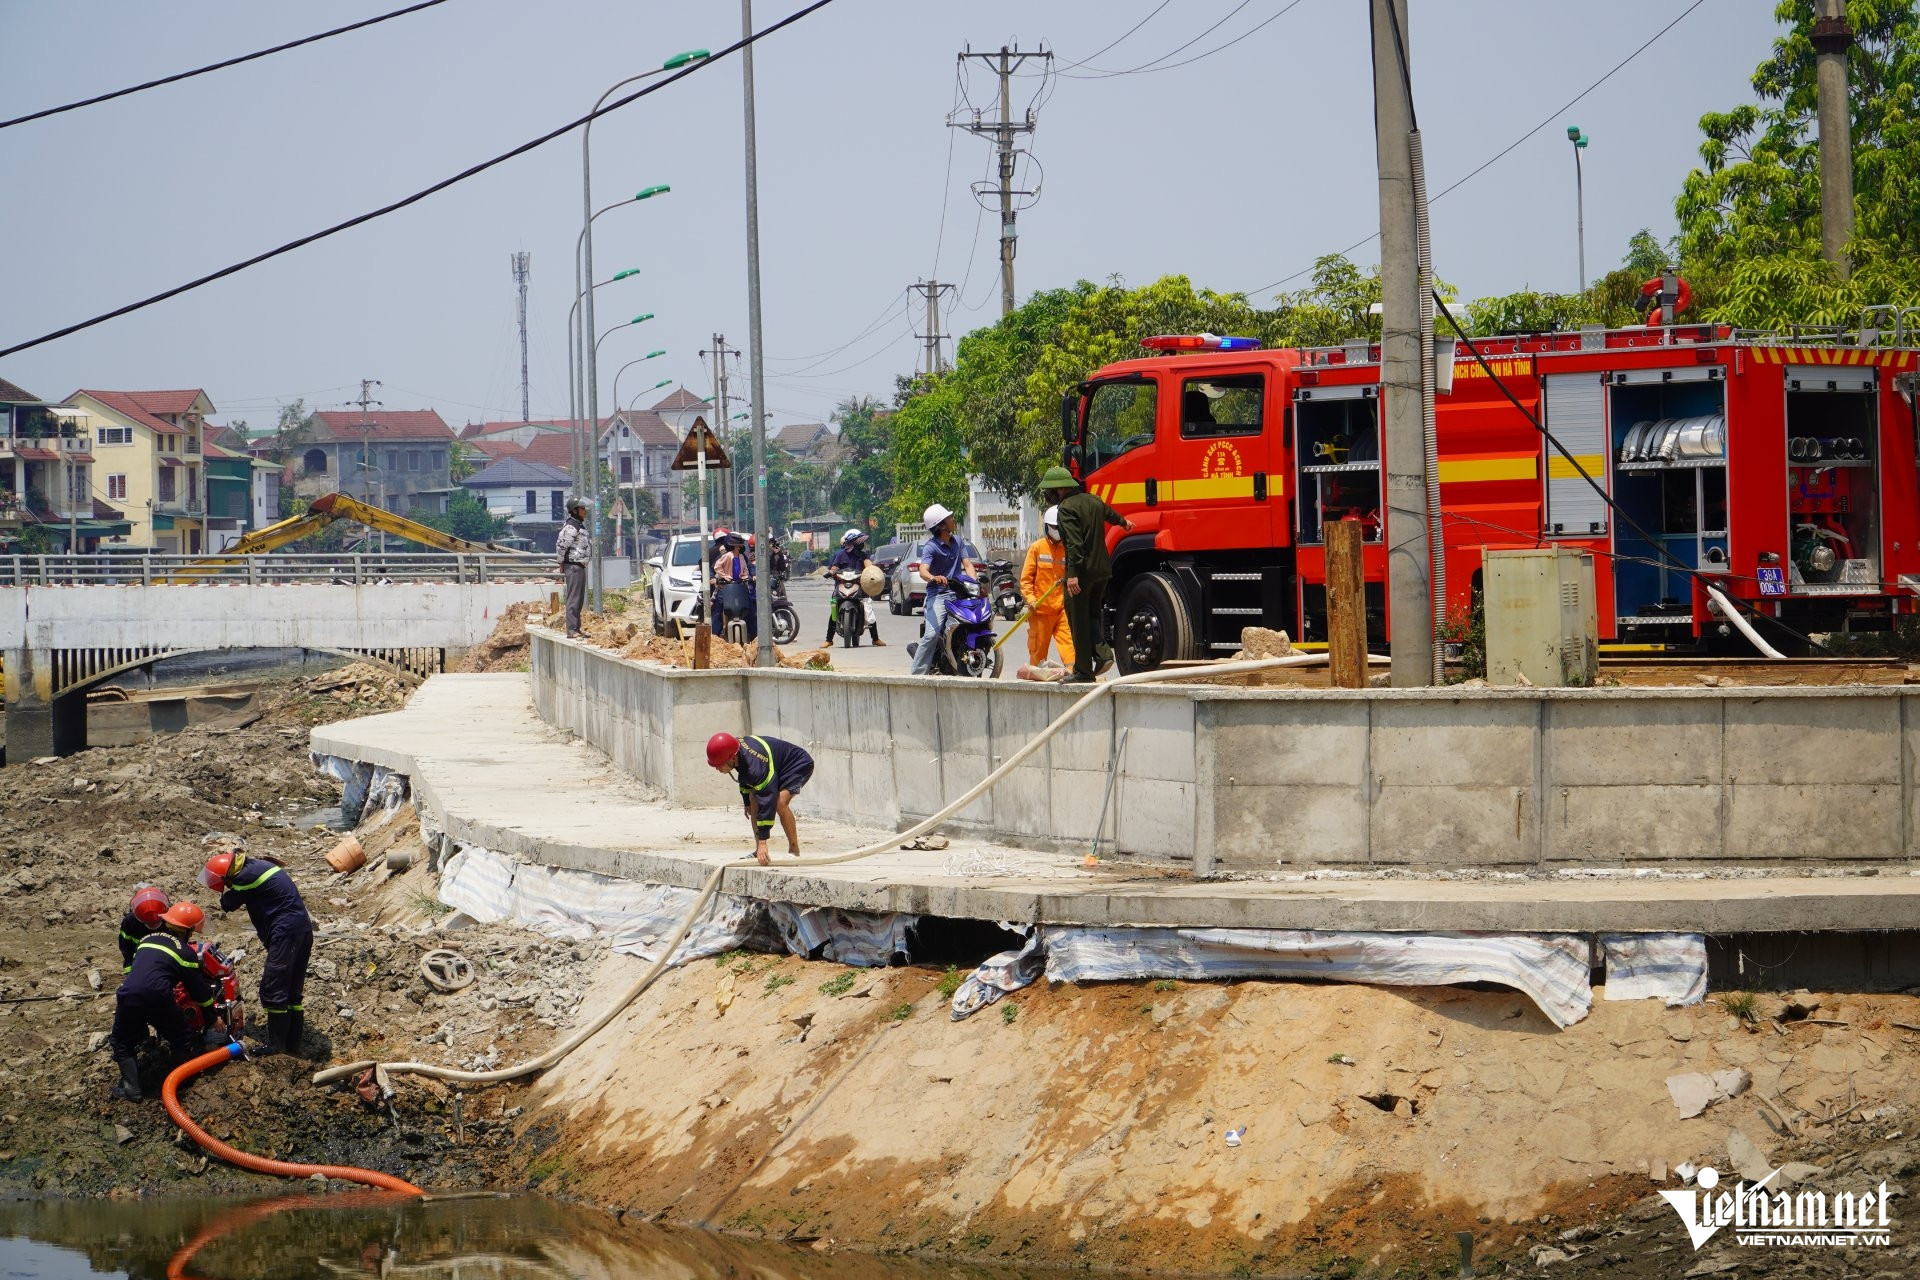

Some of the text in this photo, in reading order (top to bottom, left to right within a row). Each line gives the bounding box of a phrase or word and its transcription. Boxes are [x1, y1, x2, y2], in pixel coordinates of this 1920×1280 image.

[1454, 364, 1469, 379] NCH
[1491, 362, 1501, 376] AN
[1502, 359, 1512, 376] HÀ
[1513, 358, 1531, 376] TĨNH
[1218, 441, 1233, 451] PCCC
[1763, 570, 1777, 580] 38A
